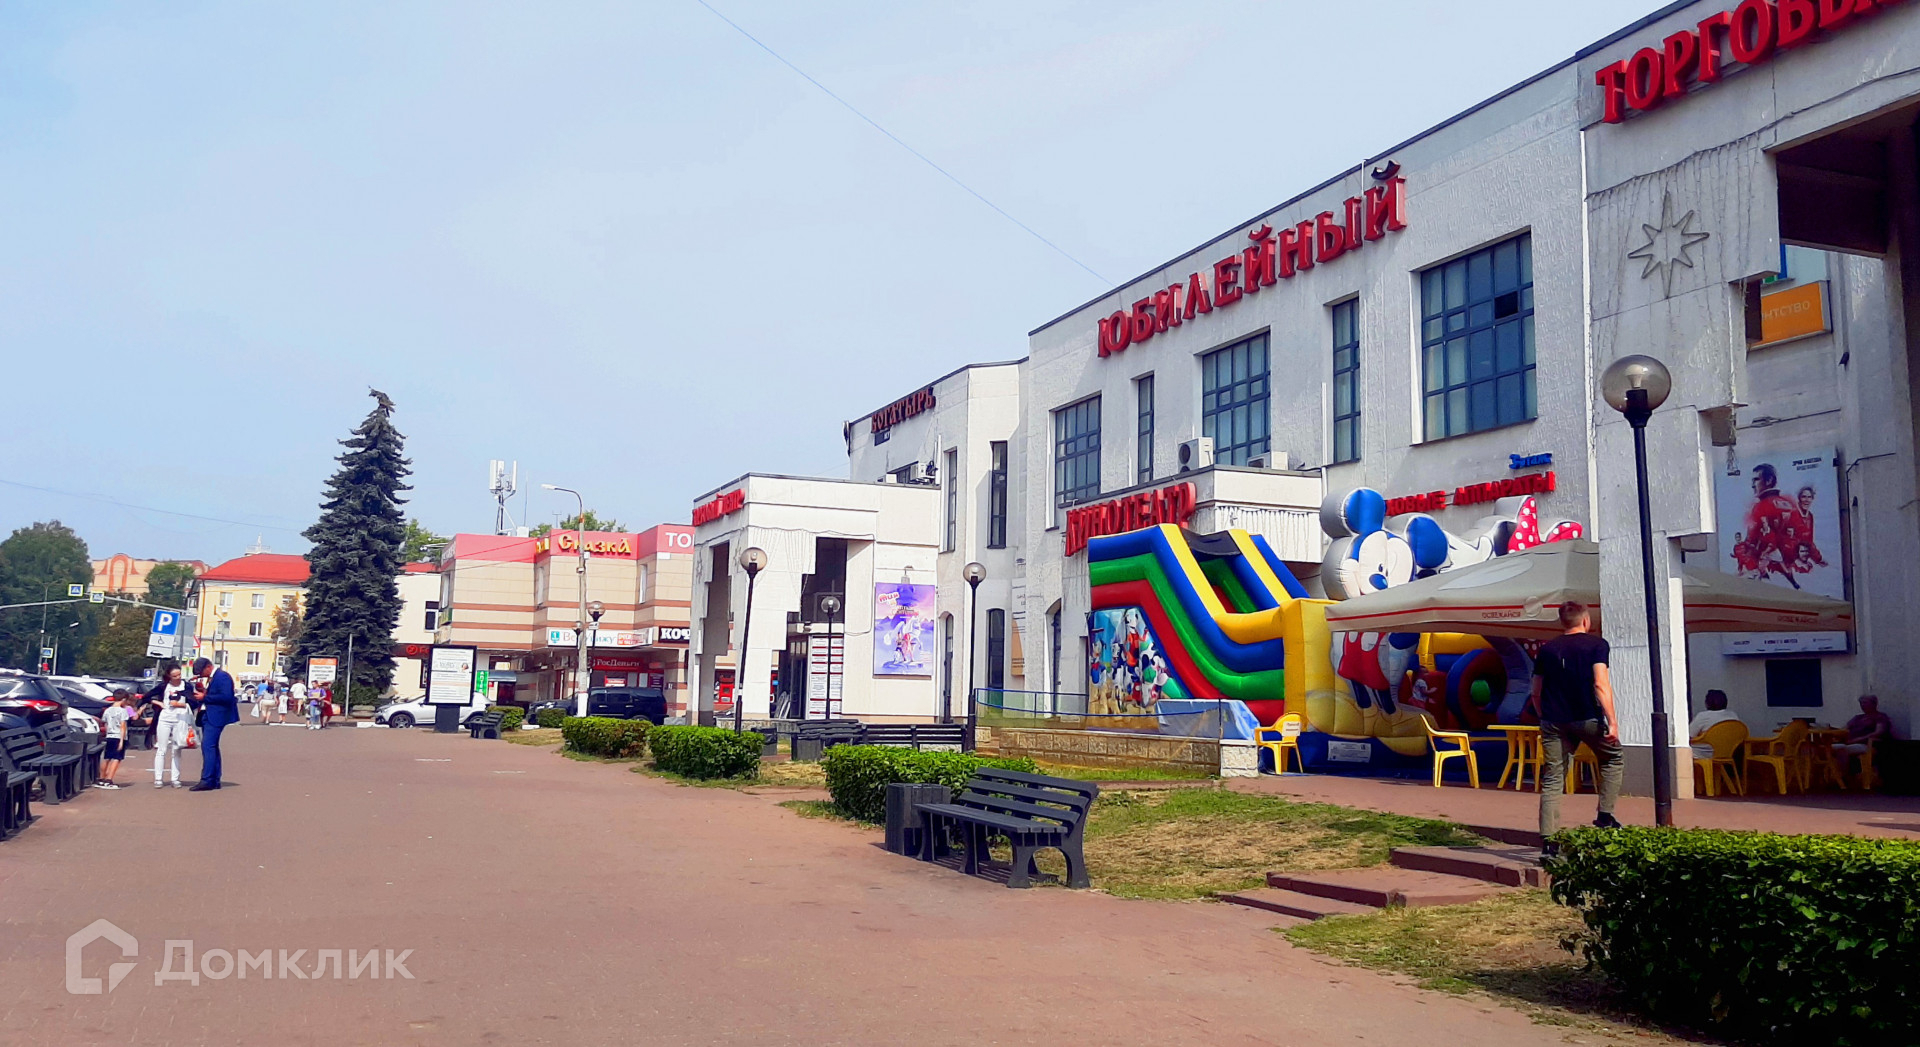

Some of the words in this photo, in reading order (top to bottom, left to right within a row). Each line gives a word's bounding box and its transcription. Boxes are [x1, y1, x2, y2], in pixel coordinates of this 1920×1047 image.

[1097, 160, 1407, 358] ЮБИЛЕЙНЫЙ
[1762, 300, 1811, 321] НТСТВО
[871, 386, 937, 434] БОГАТЫРЬ
[1453, 470, 1556, 506] АППАРАТЫ
[1065, 481, 1197, 557] КИНОТЕАТР
[665, 531, 695, 549] ТО
[157, 612, 173, 632] P
